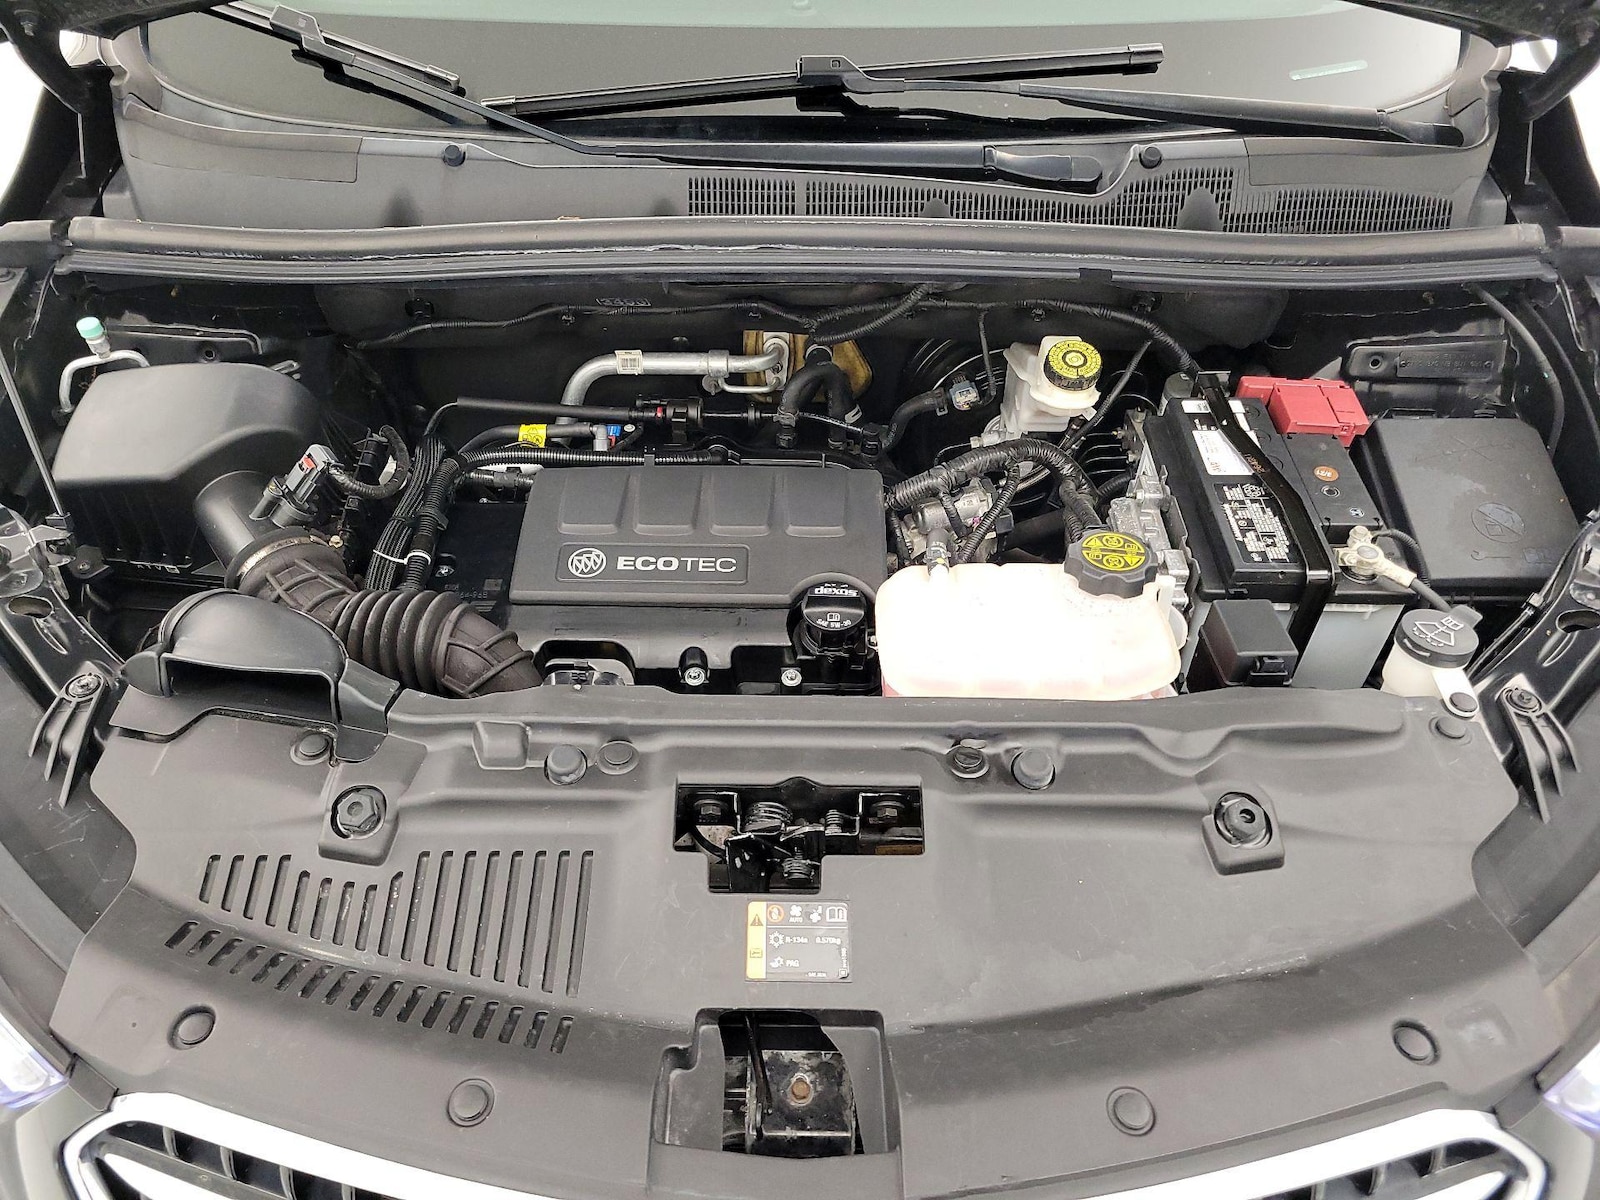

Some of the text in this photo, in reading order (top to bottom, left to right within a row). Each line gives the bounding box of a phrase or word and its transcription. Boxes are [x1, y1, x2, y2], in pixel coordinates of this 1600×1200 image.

[616, 556, 737, 573] ECOTEC
[814, 586, 858, 597] dexos
[816, 618, 829, 628] SAE
[785, 936, 809, 944] R-134a
